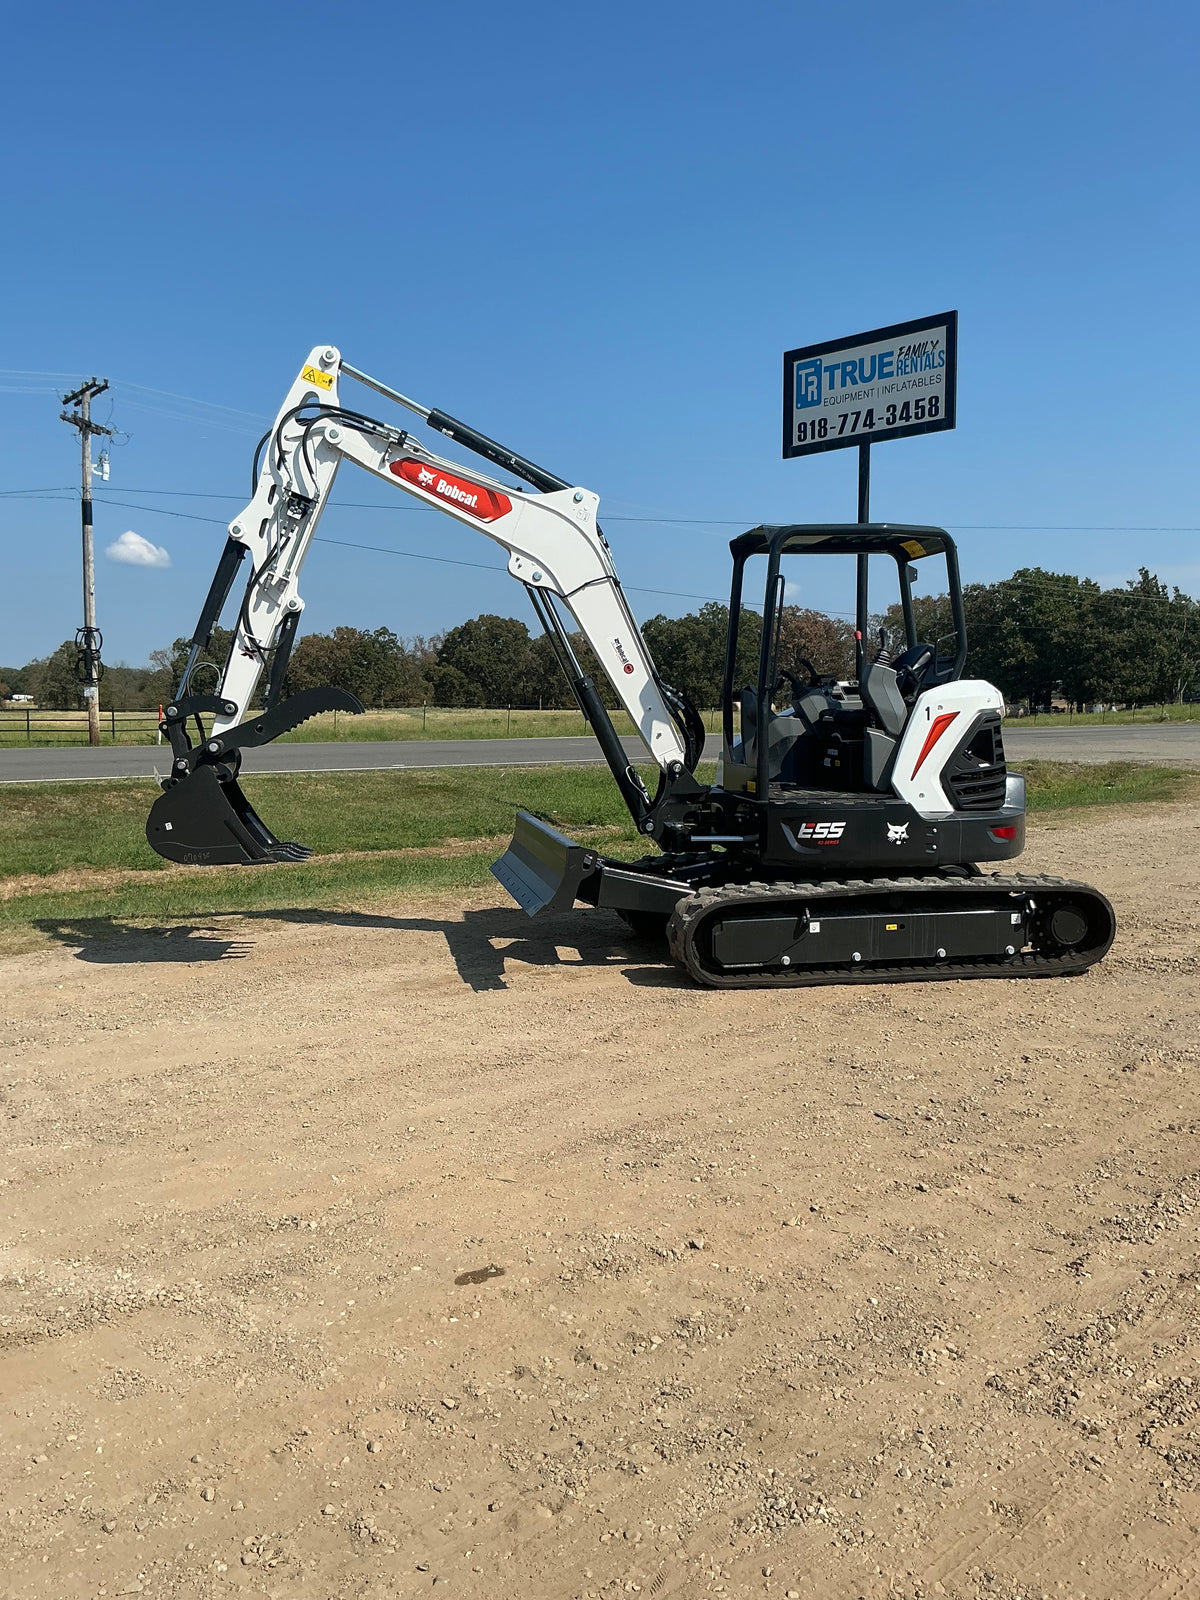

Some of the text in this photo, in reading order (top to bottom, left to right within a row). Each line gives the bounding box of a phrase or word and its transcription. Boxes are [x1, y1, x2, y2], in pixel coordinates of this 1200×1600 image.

[896, 350, 945, 377] RENTALS
[897, 340, 939, 361] FAMILY
[823, 350, 895, 391] TRUE
[823, 374, 942, 407] EQUIPMENT INFLATABLES
[797, 395, 940, 443] 918-774-3458
[436, 479, 478, 508] Bobcat
[925, 706, 930, 721] 1
